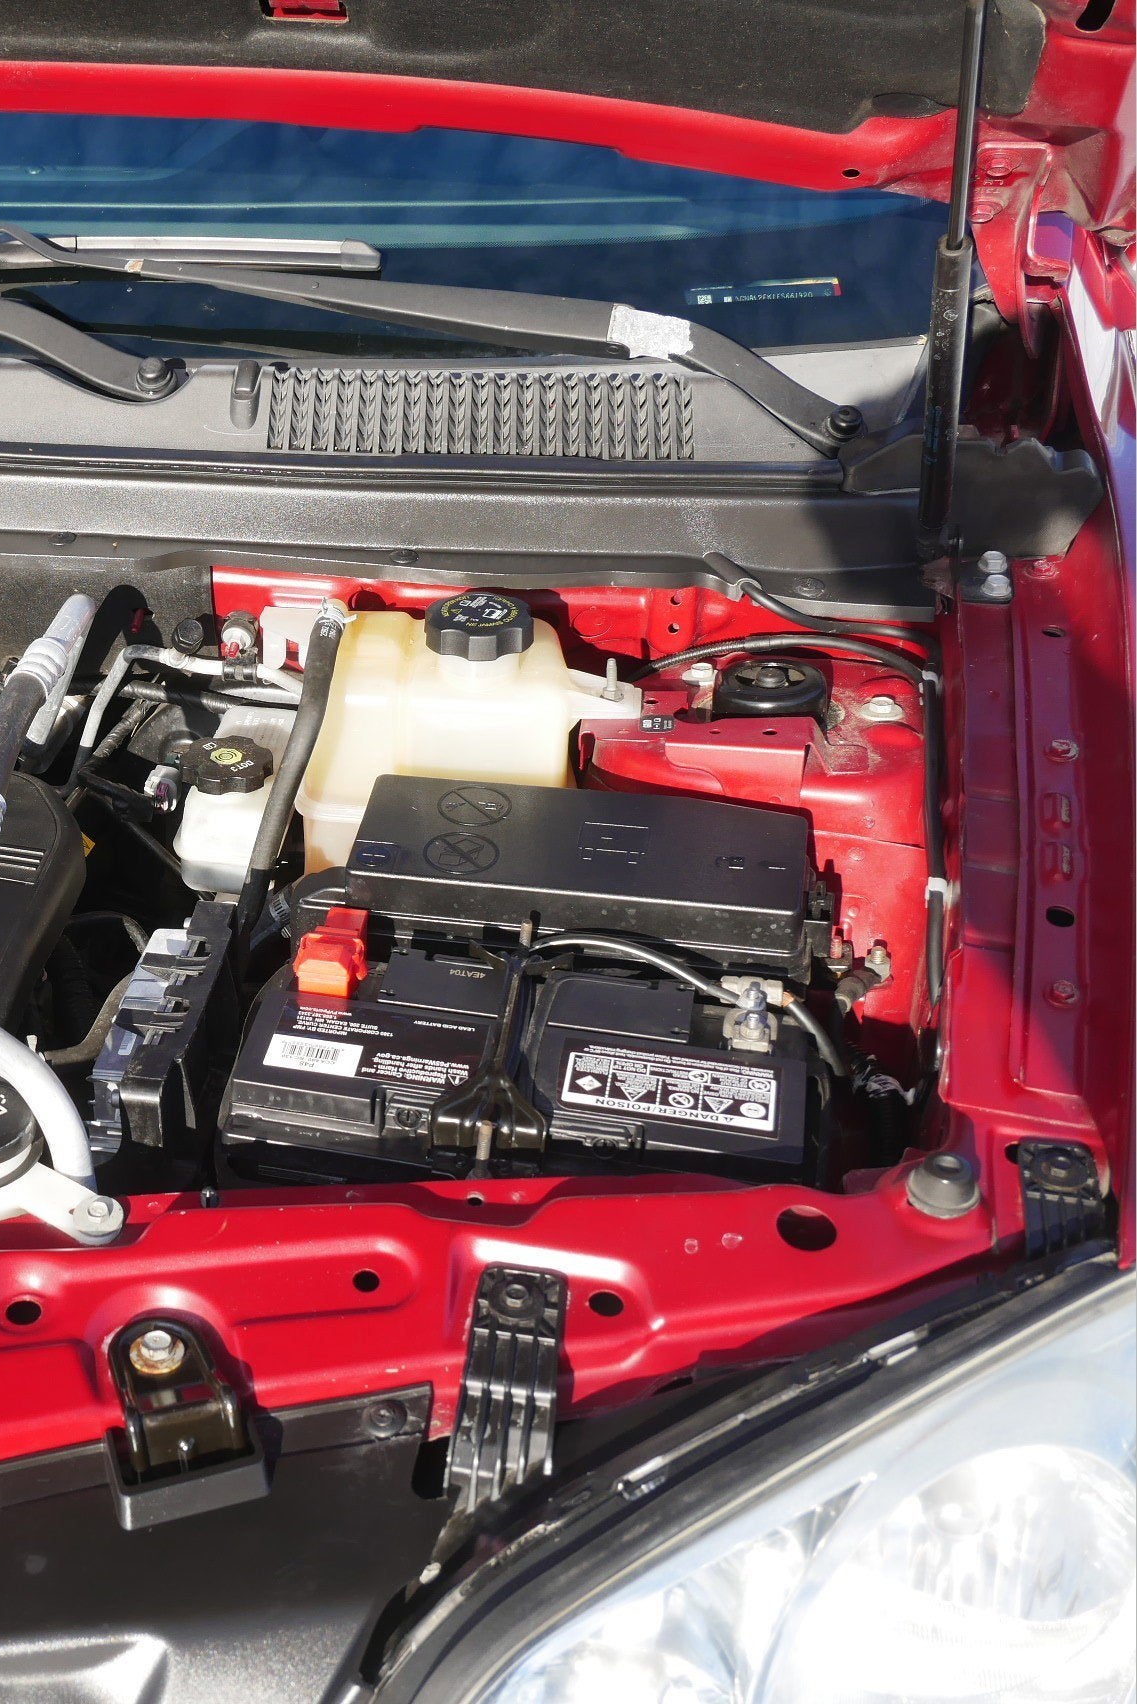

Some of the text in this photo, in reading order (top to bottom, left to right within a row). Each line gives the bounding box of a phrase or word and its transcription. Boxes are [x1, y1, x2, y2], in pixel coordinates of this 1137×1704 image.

[449, 968, 486, 979] 4EAT04
[414, 1020, 442, 1028] BATTERY
[378, 1070, 402, 1078] Cancer
[399, 1067, 446, 1078] Reproductive
[448, 1068, 468, 1076] Wash
[405, 1073, 445, 1084] WARNING:
[595, 1098, 719, 1122] DANGER/POISON
